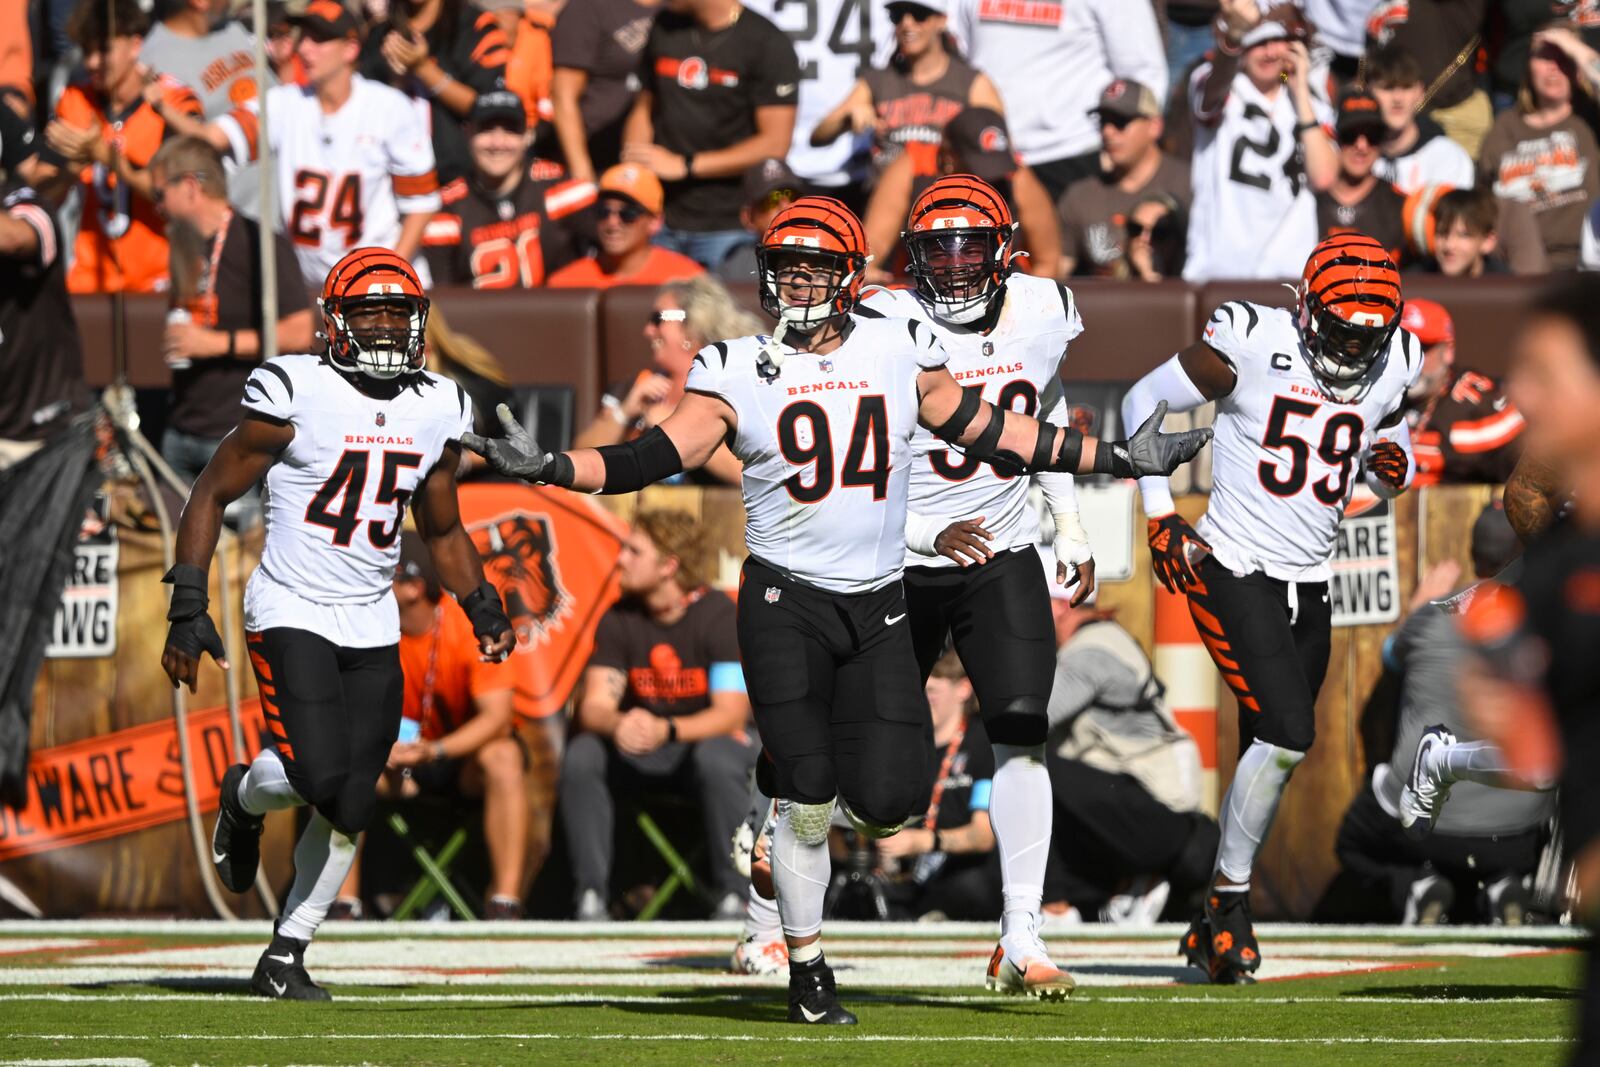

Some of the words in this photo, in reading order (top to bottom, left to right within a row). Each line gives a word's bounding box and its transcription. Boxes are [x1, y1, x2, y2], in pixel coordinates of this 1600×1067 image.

[773, 0, 876, 80] 24
[290, 168, 364, 247] 24
[954, 362, 1024, 381] BENGALS
[1270, 352, 1293, 371] C
[787, 380, 870, 396] BENGALS
[343, 434, 414, 446] BENGALS
[776, 394, 893, 504] 94
[1257, 394, 1365, 506] 59
[304, 448, 425, 549] 45
[67, 554, 109, 585] RE
[60, 600, 109, 645] WG
